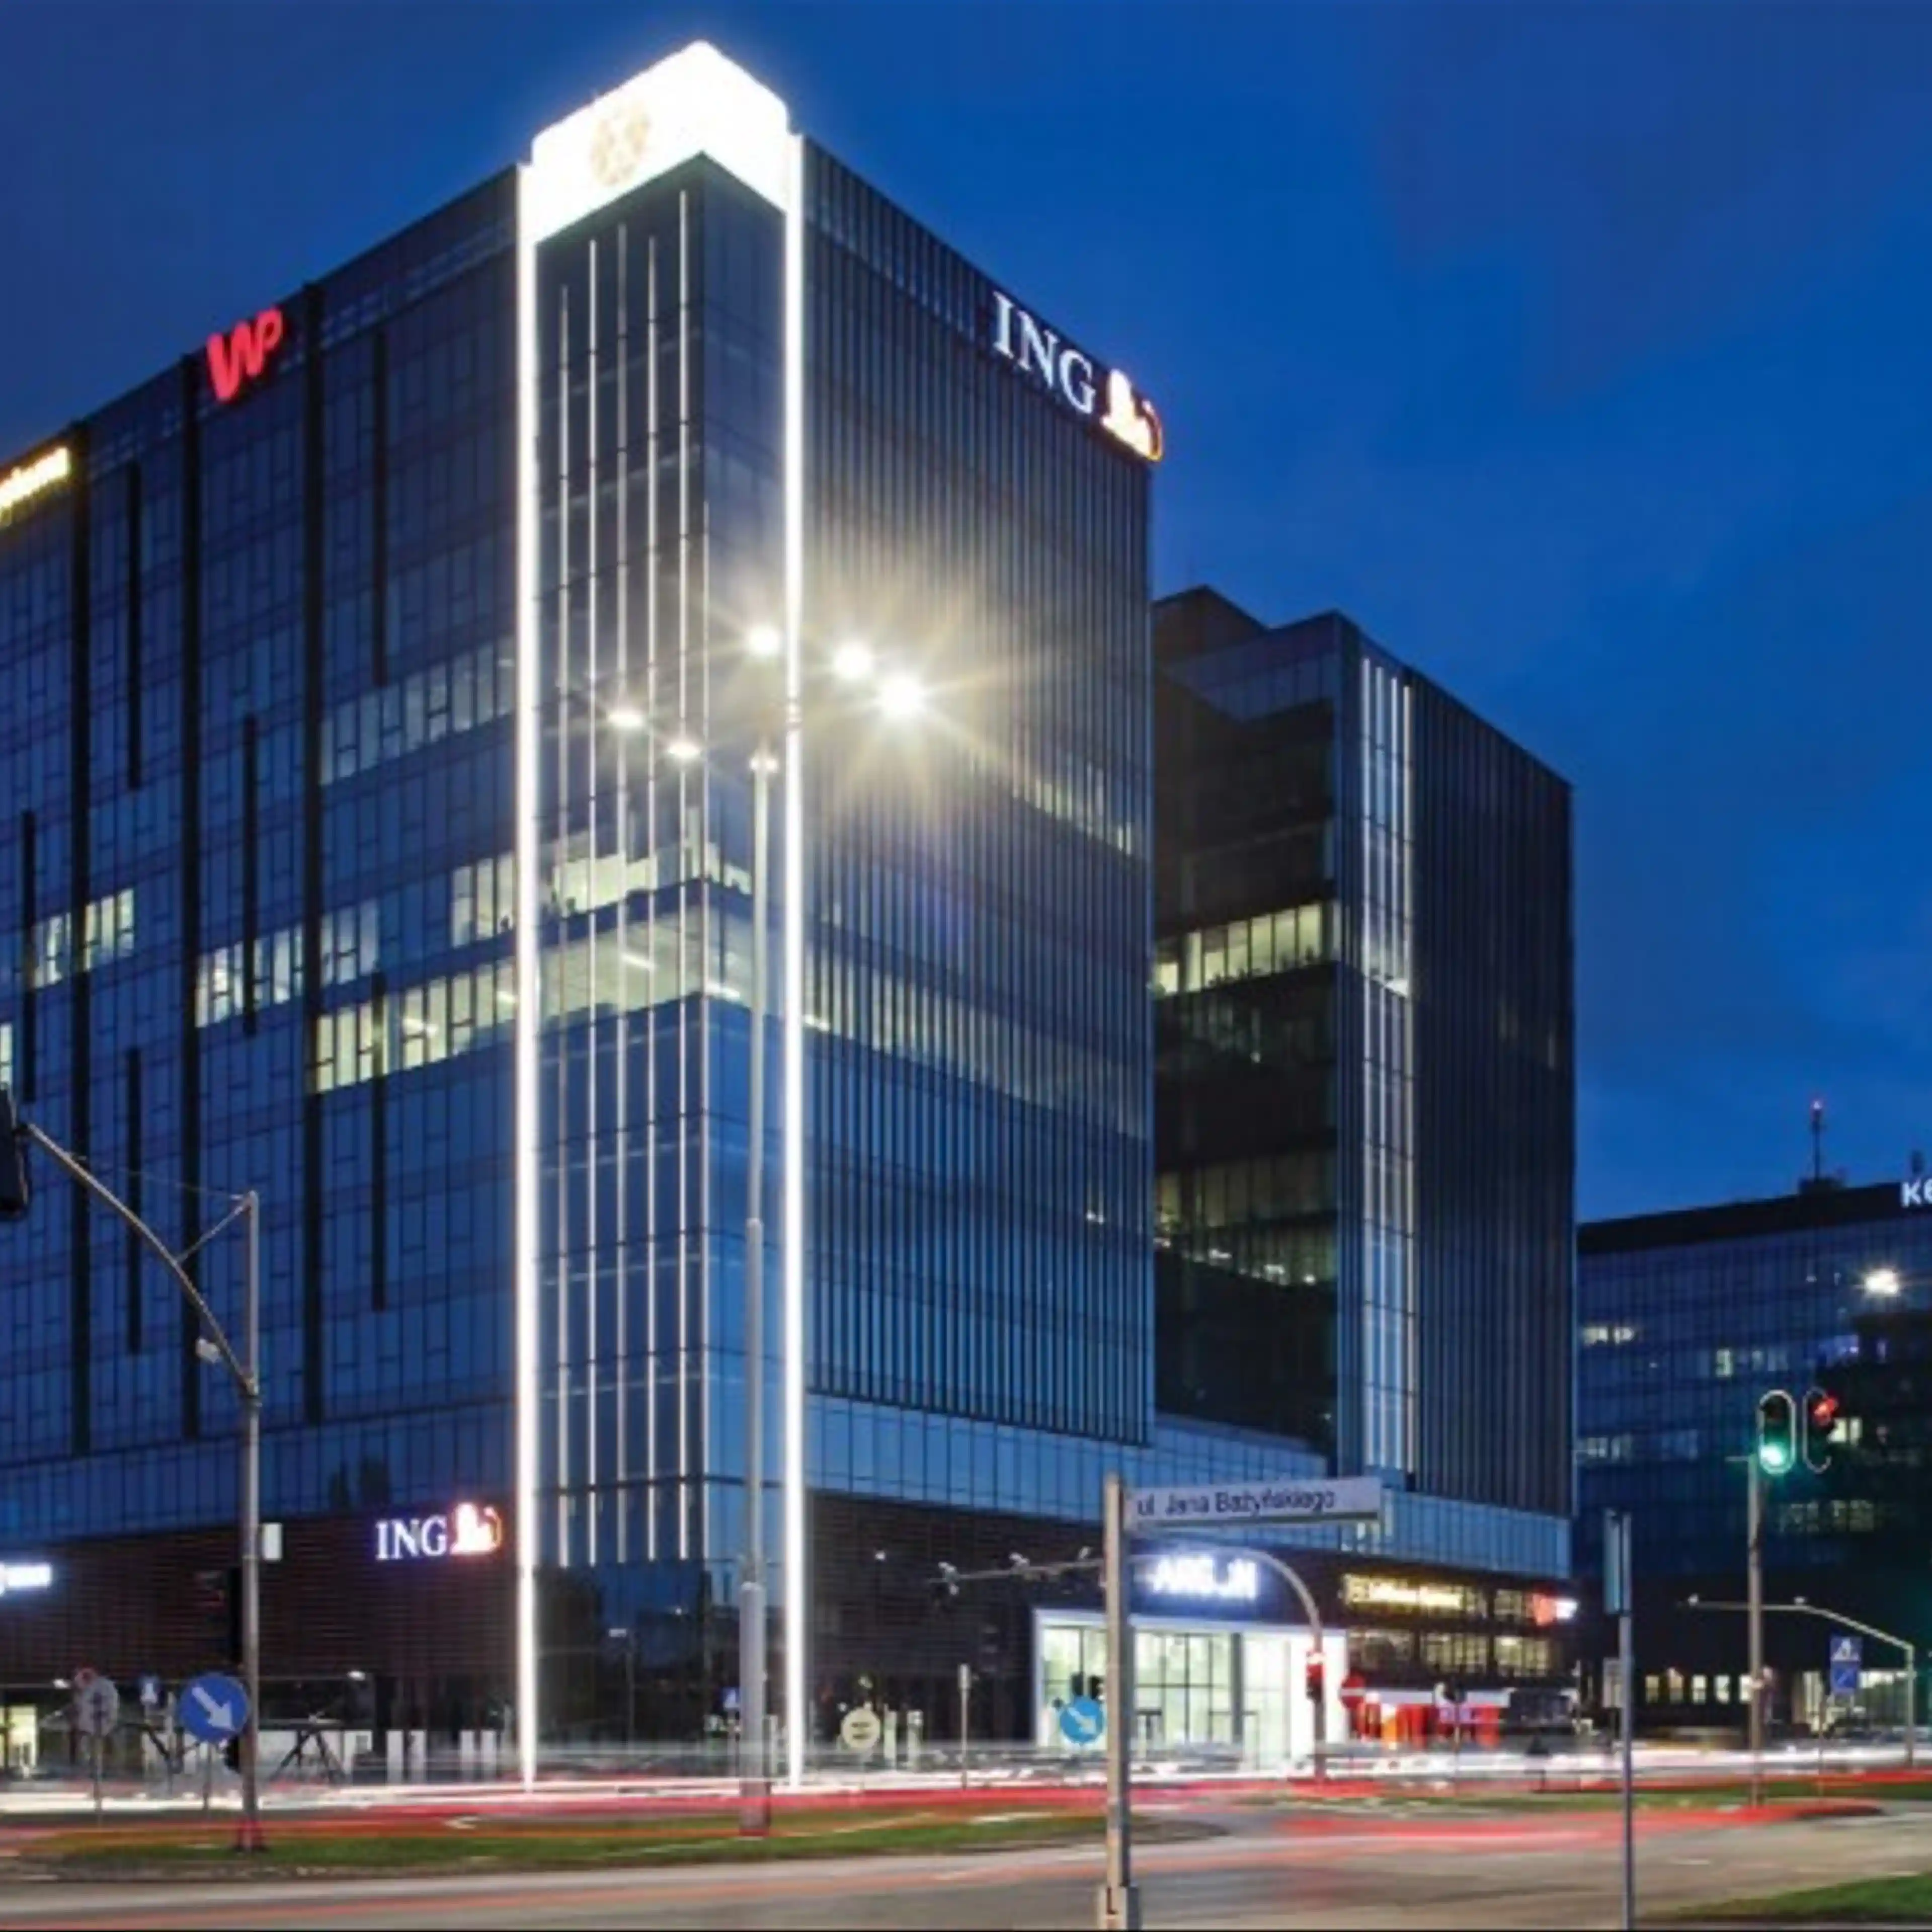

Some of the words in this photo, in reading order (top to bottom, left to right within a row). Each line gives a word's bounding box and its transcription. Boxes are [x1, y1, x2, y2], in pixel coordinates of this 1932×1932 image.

[207, 306, 283, 401] WP
[993, 290, 1096, 415] ING
[375, 1515, 447, 1560] ING
